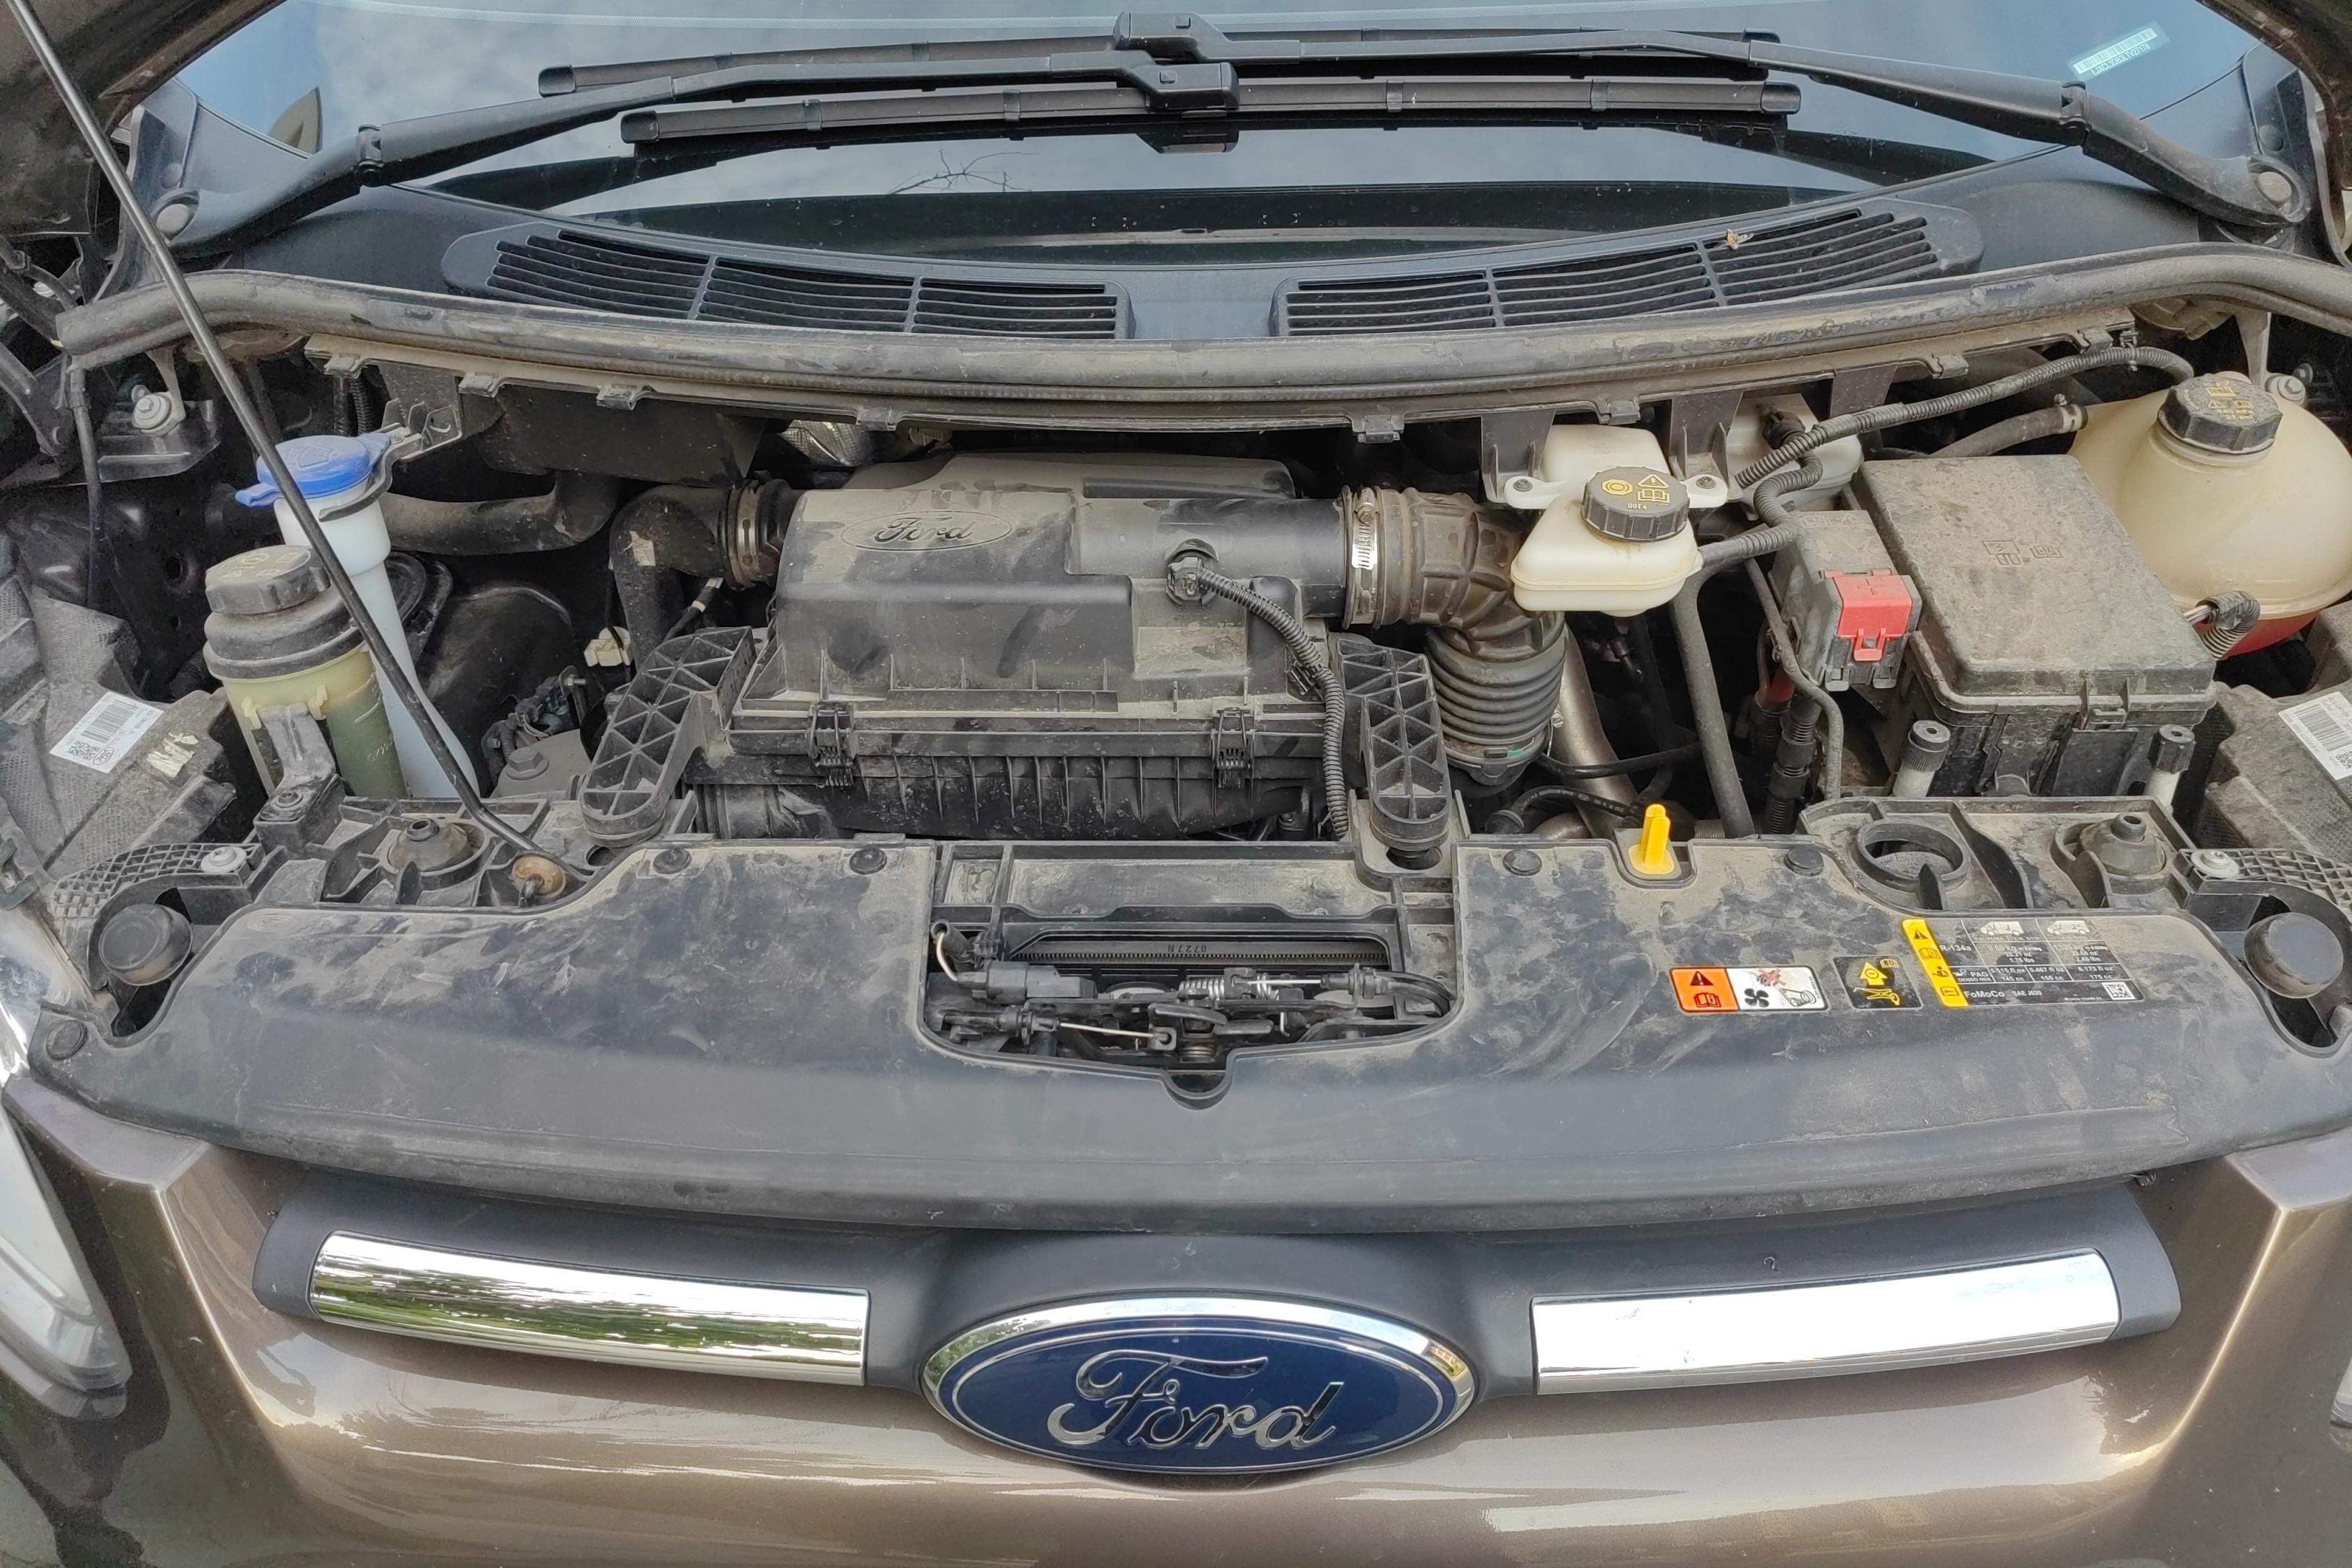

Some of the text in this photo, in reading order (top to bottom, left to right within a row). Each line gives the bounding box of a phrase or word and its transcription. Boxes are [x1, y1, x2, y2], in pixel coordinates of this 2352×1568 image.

[873, 516, 977, 543] Ford
[1167, 944, 1207, 953] 0727N
[1046, 1348, 1345, 1449] Ford
